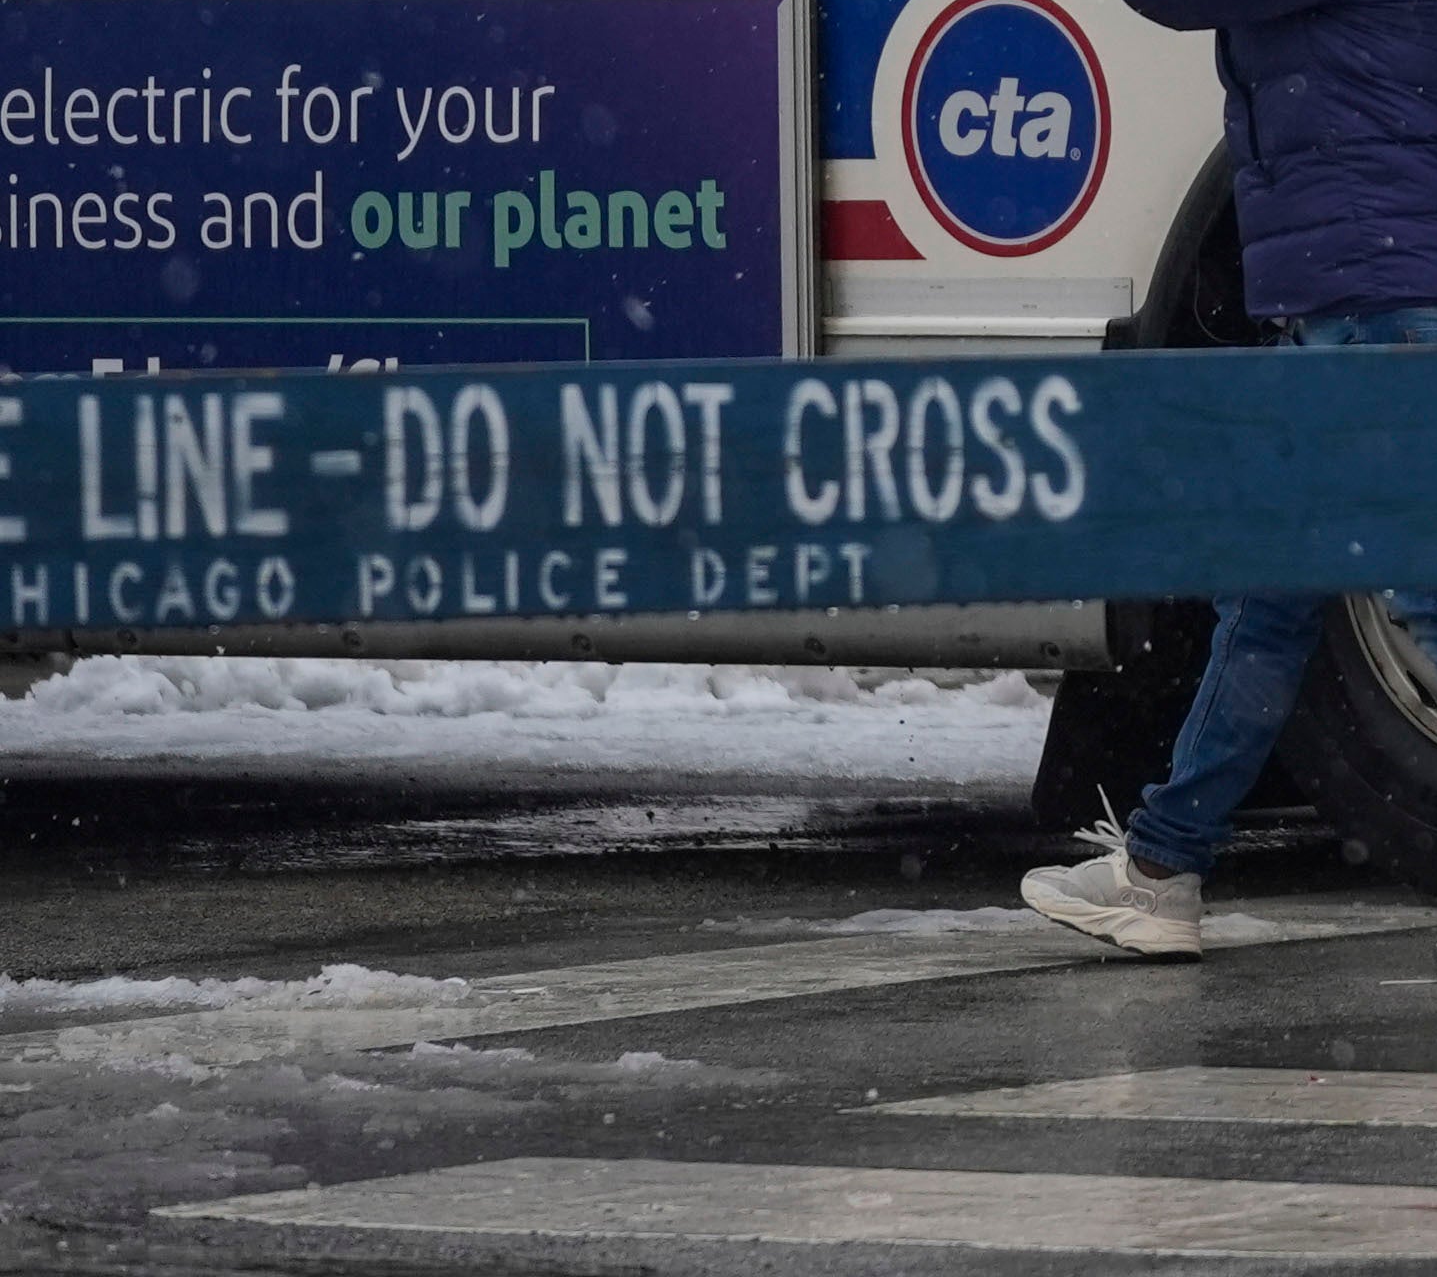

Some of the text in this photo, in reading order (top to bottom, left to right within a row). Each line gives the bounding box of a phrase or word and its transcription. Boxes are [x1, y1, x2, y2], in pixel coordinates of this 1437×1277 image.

[0, 64, 555, 162] electric for your
[938, 76, 1073, 159] cta
[0, 170, 727, 268] iness and our planet
[78, 392, 289, 542] LINE
[383, 382, 508, 532] DO
[560, 380, 734, 528] NOT
[783, 375, 1087, 526] CROSS
[358, 548, 629, 617] POLICE
[690, 542, 871, 608] DEPT
